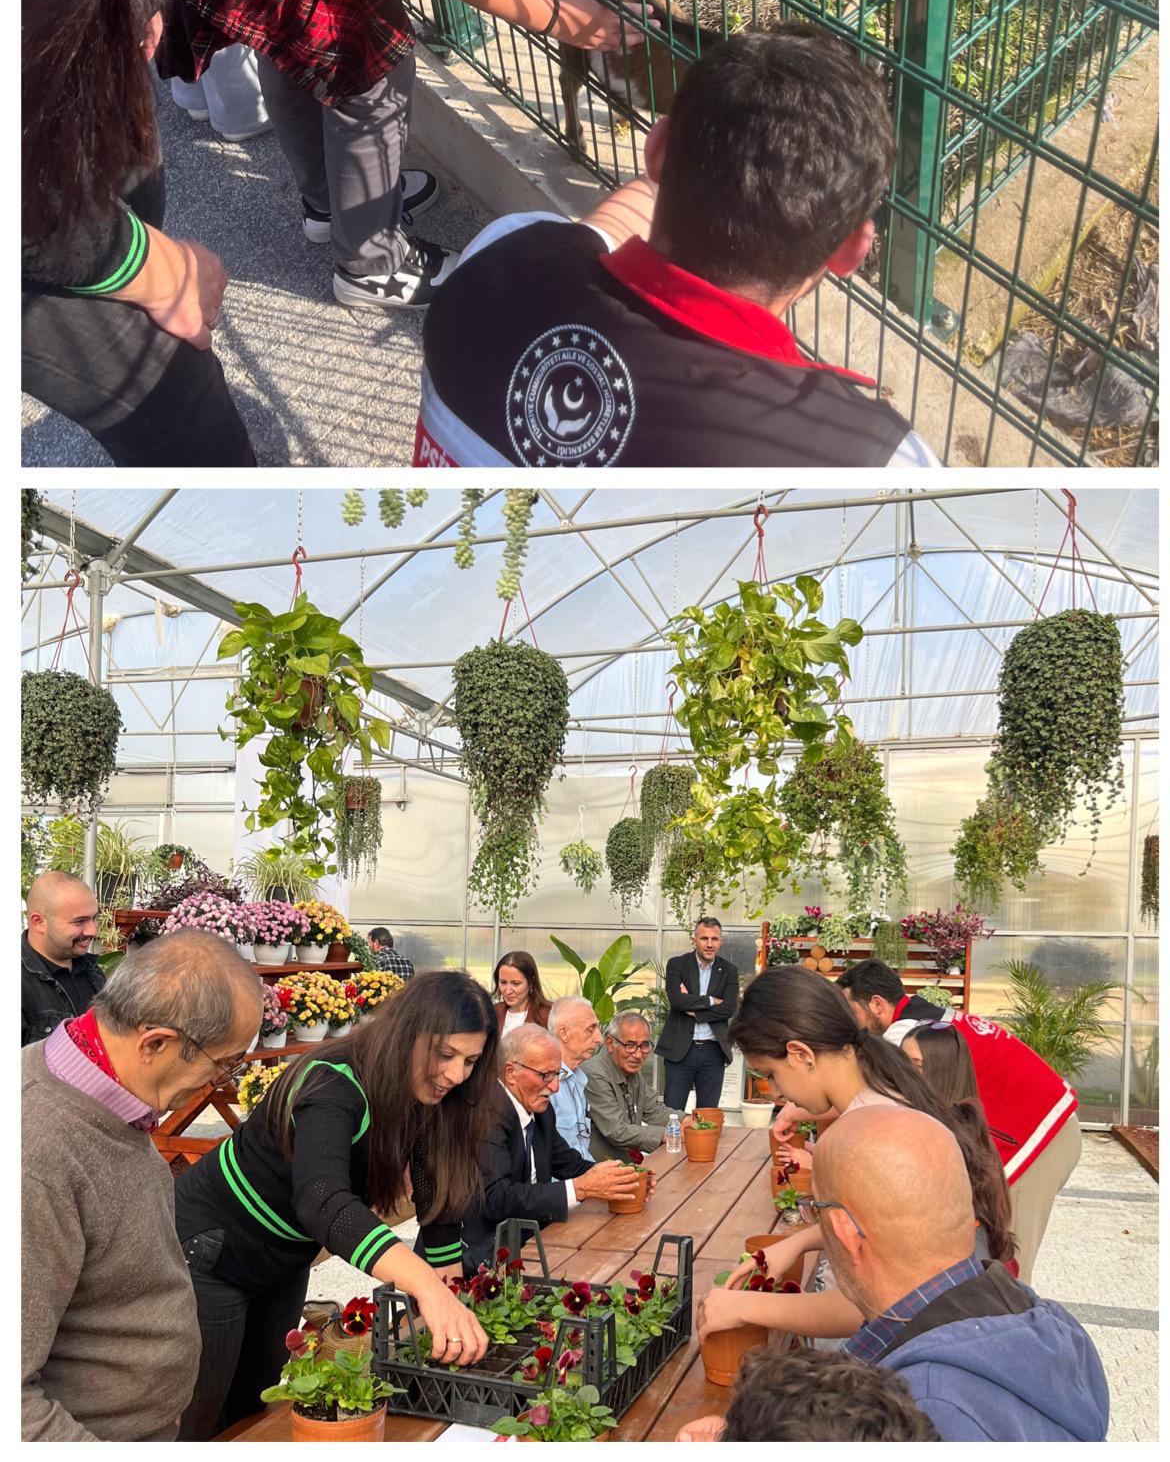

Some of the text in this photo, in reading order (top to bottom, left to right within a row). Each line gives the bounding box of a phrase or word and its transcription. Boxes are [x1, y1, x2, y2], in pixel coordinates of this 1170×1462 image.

[528, 353, 561, 402] CUMHURİYETİ
[562, 351, 576, 360] AİLE
[585, 360, 605, 388] SOSYAL
